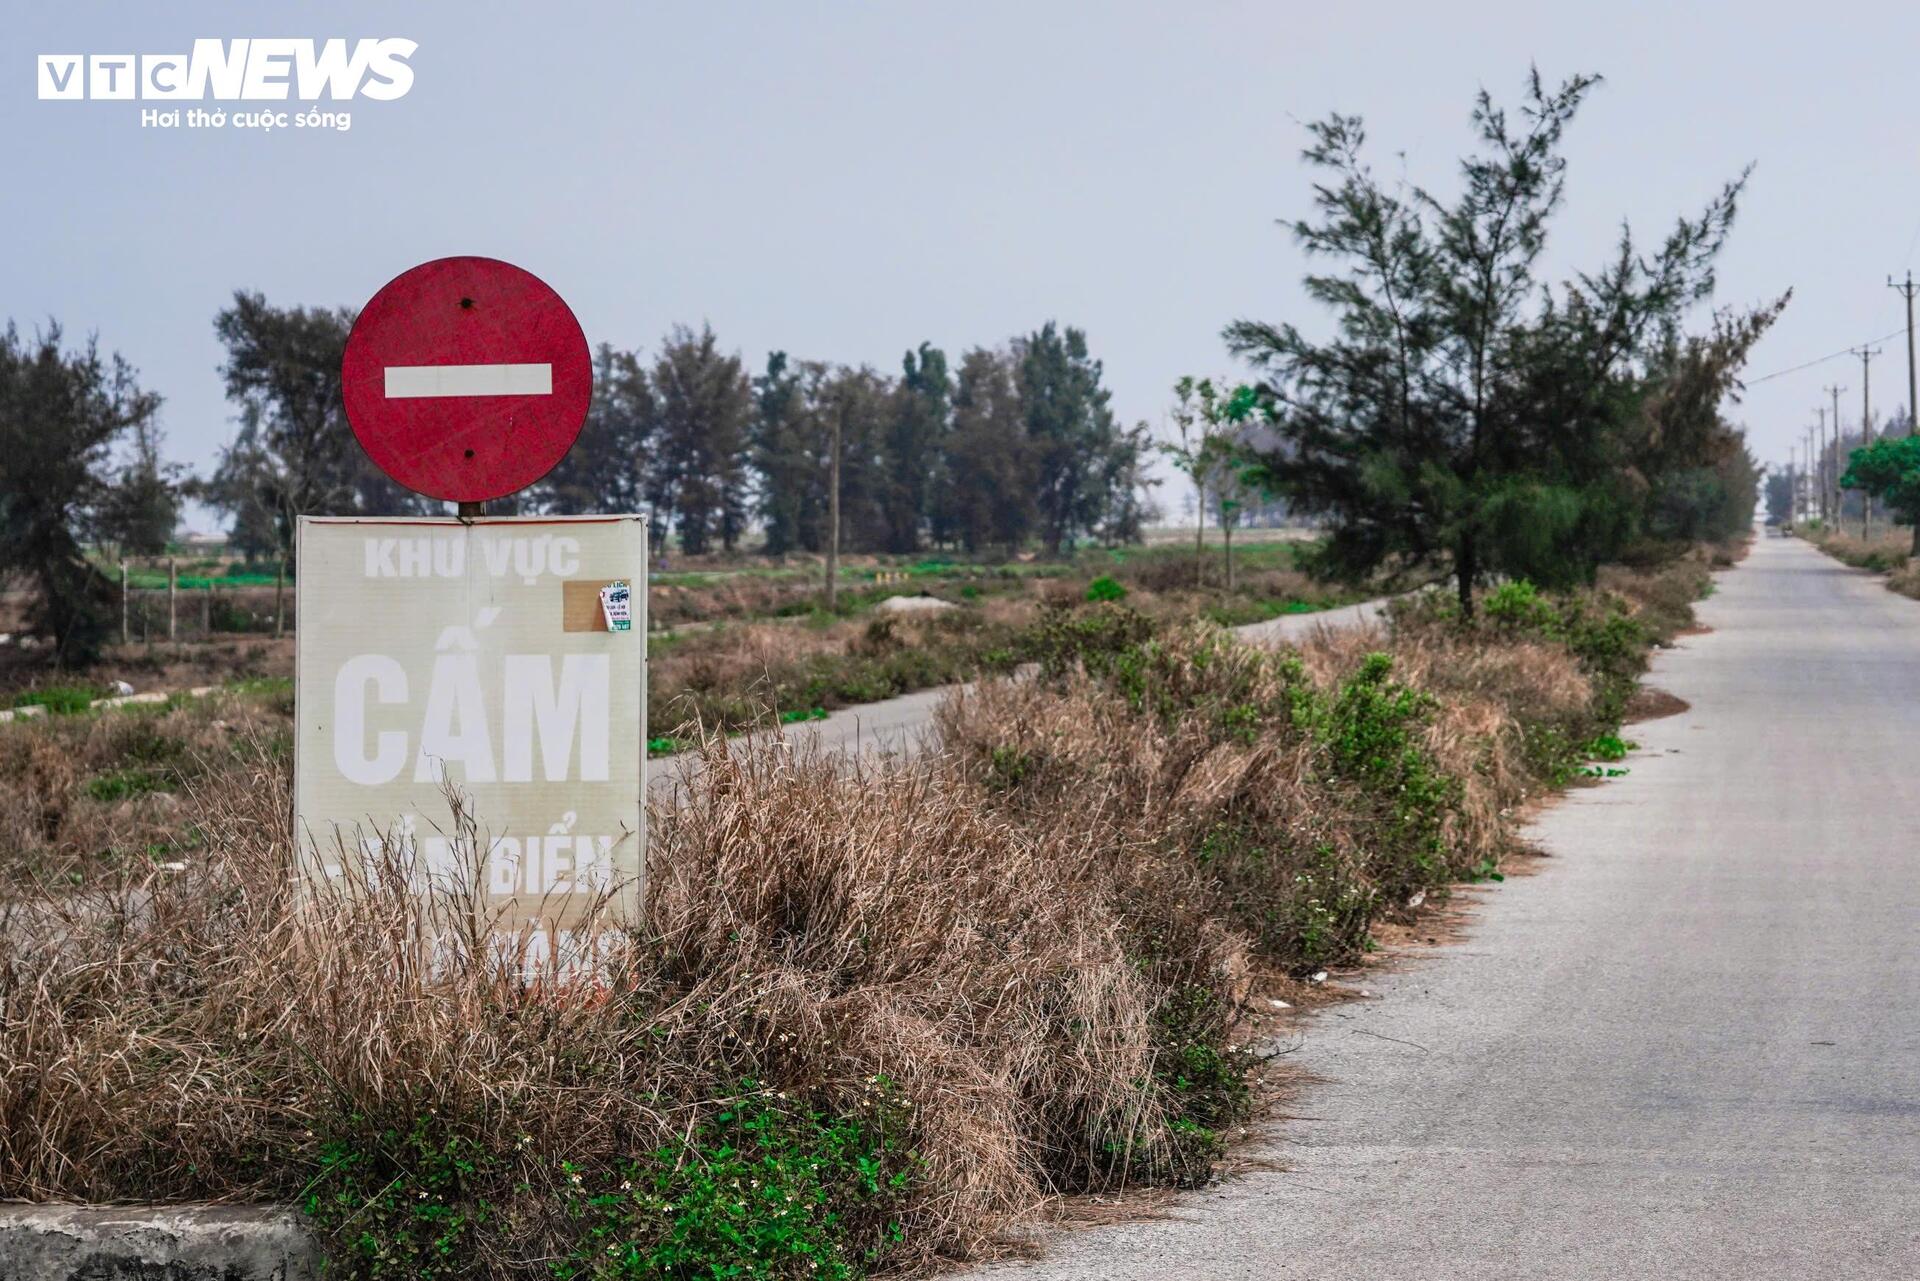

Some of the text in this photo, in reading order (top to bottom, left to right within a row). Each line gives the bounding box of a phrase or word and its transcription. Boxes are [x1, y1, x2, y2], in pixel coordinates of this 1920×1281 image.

[364, 533, 580, 586] KHU VỰC
[334, 606, 610, 786] CẤM
[490, 810, 612, 896] BIỂN
